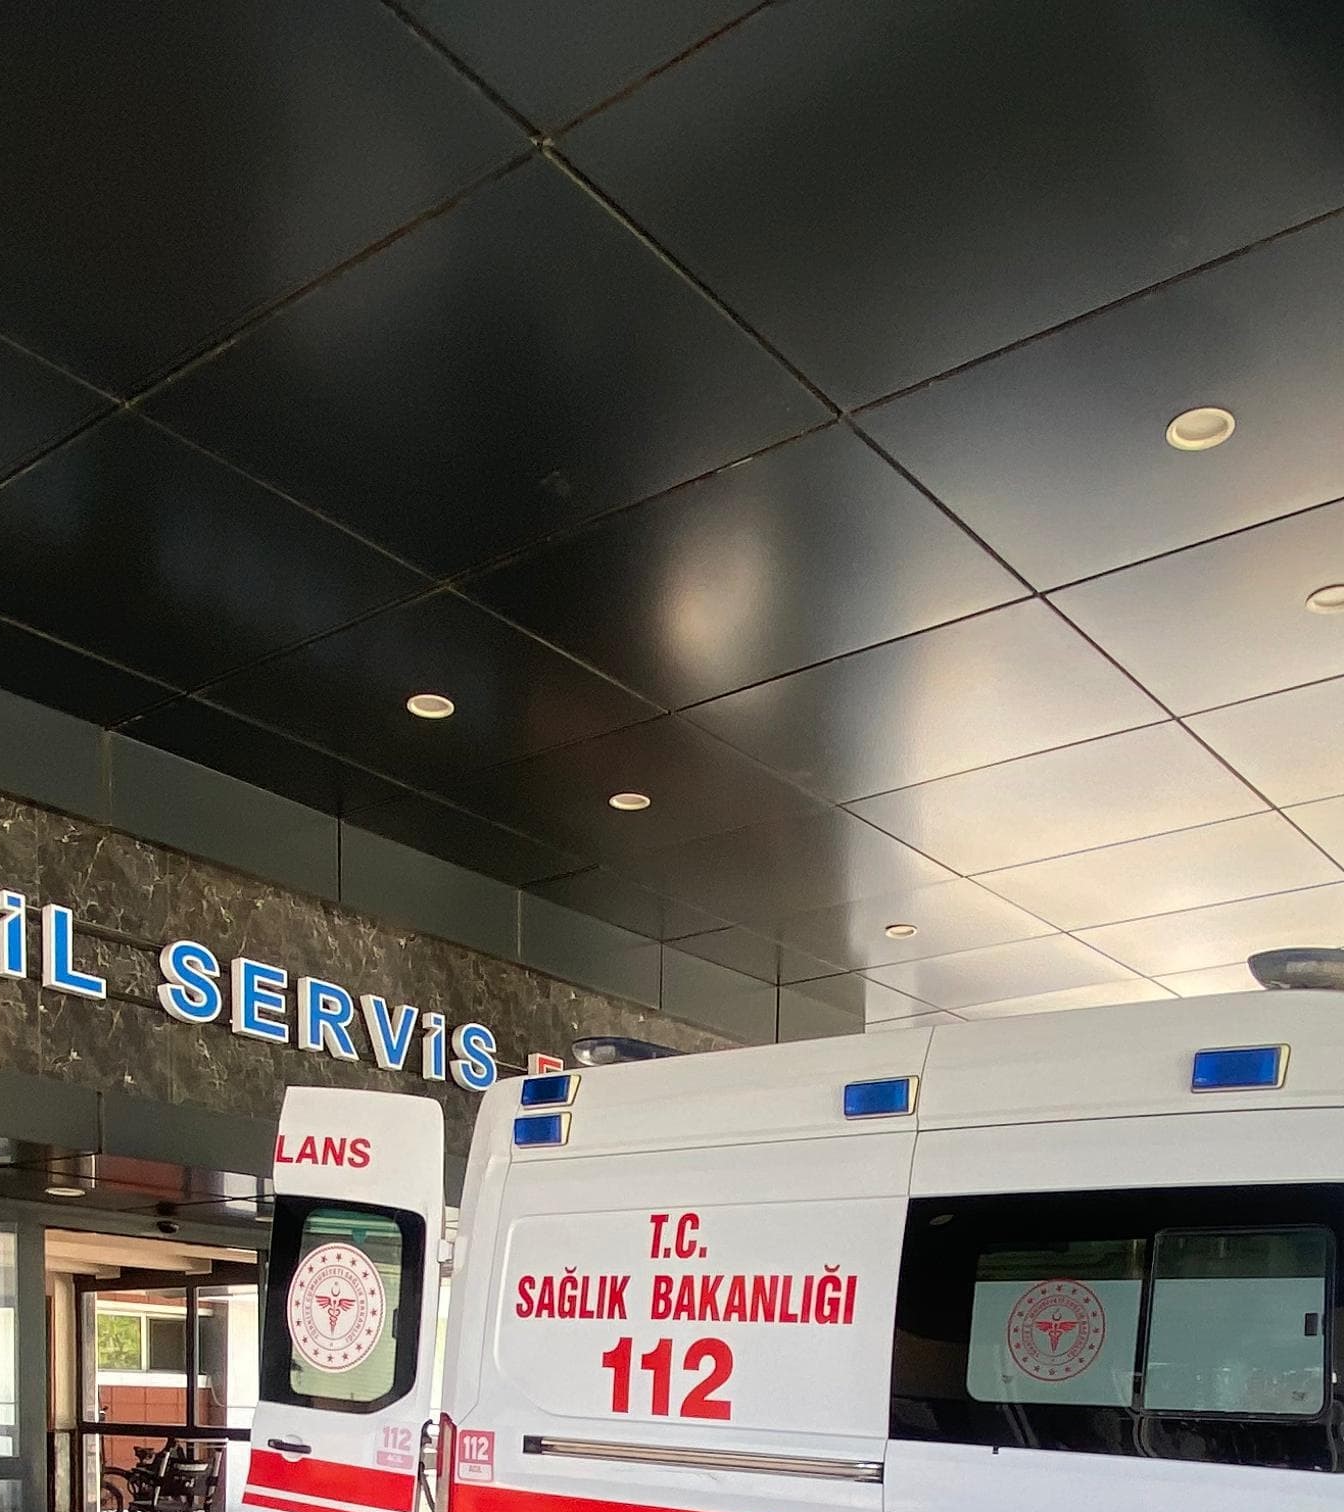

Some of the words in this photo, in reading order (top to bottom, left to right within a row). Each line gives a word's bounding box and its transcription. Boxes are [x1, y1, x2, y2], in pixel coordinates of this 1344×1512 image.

[276, 1135, 371, 1168] LANS
[650, 1213, 707, 1259] T.C.
[515, 1265, 631, 1320] SAĞLIK
[650, 1264, 858, 1325] BAKANLIĞI
[602, 1336, 733, 1421] 112
[383, 1424, 412, 1451] 112
[463, 1435, 489, 1461] 112
